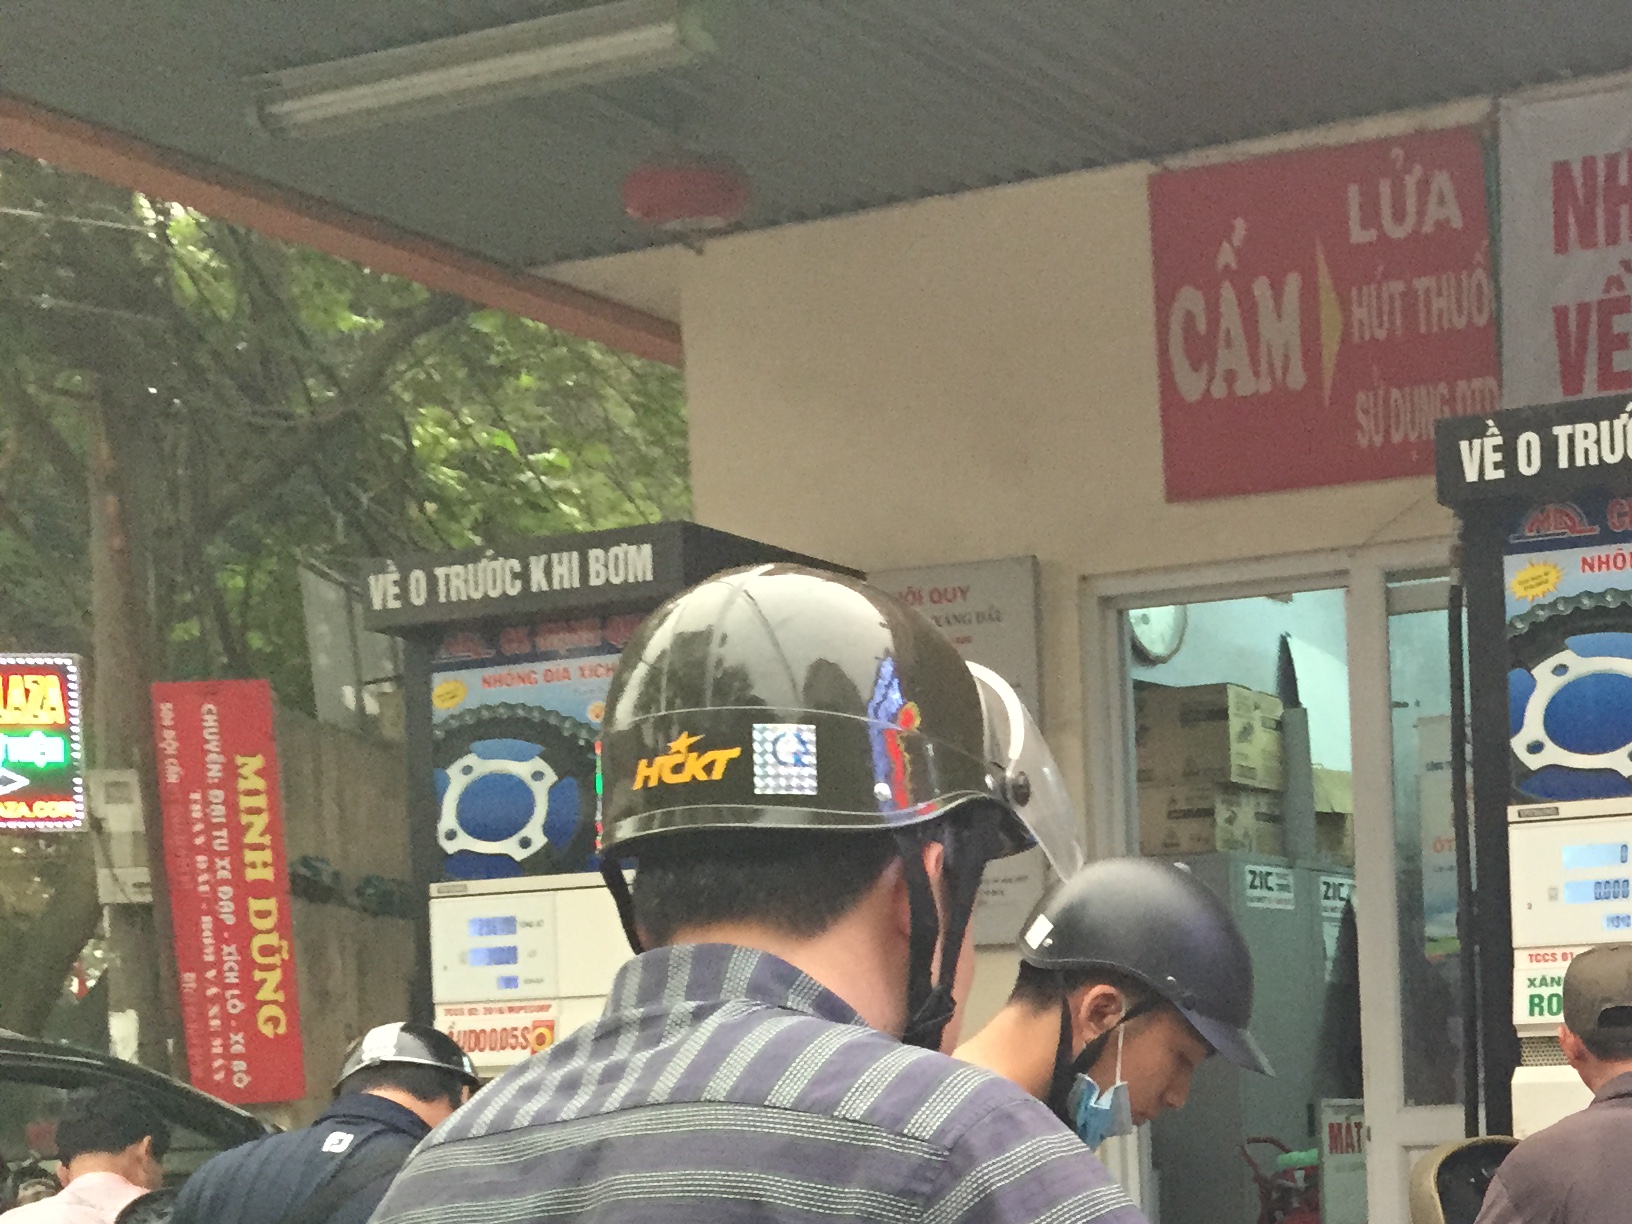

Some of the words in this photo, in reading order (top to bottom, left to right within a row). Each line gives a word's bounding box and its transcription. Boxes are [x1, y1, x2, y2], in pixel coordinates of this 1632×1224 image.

[1348, 147, 1463, 245] LỬA
[1168, 217, 1307, 403] CẤM
[1350, 264, 1406, 344] HÚT
[1459, 418, 1504, 483] VỀ
[368, 559, 402, 611] VỀ
[433, 549, 522, 603] TRƯỚC
[528, 551, 580, 592] KHI
[587, 543, 654, 587] BƠM
[235, 754, 275, 882] MINH
[222, 944, 241, 983] XÍCH
[248, 896, 289, 1039] DŨNG
[1528, 952, 1557, 963] TCCS
[229, 1032, 245, 1054] XE
